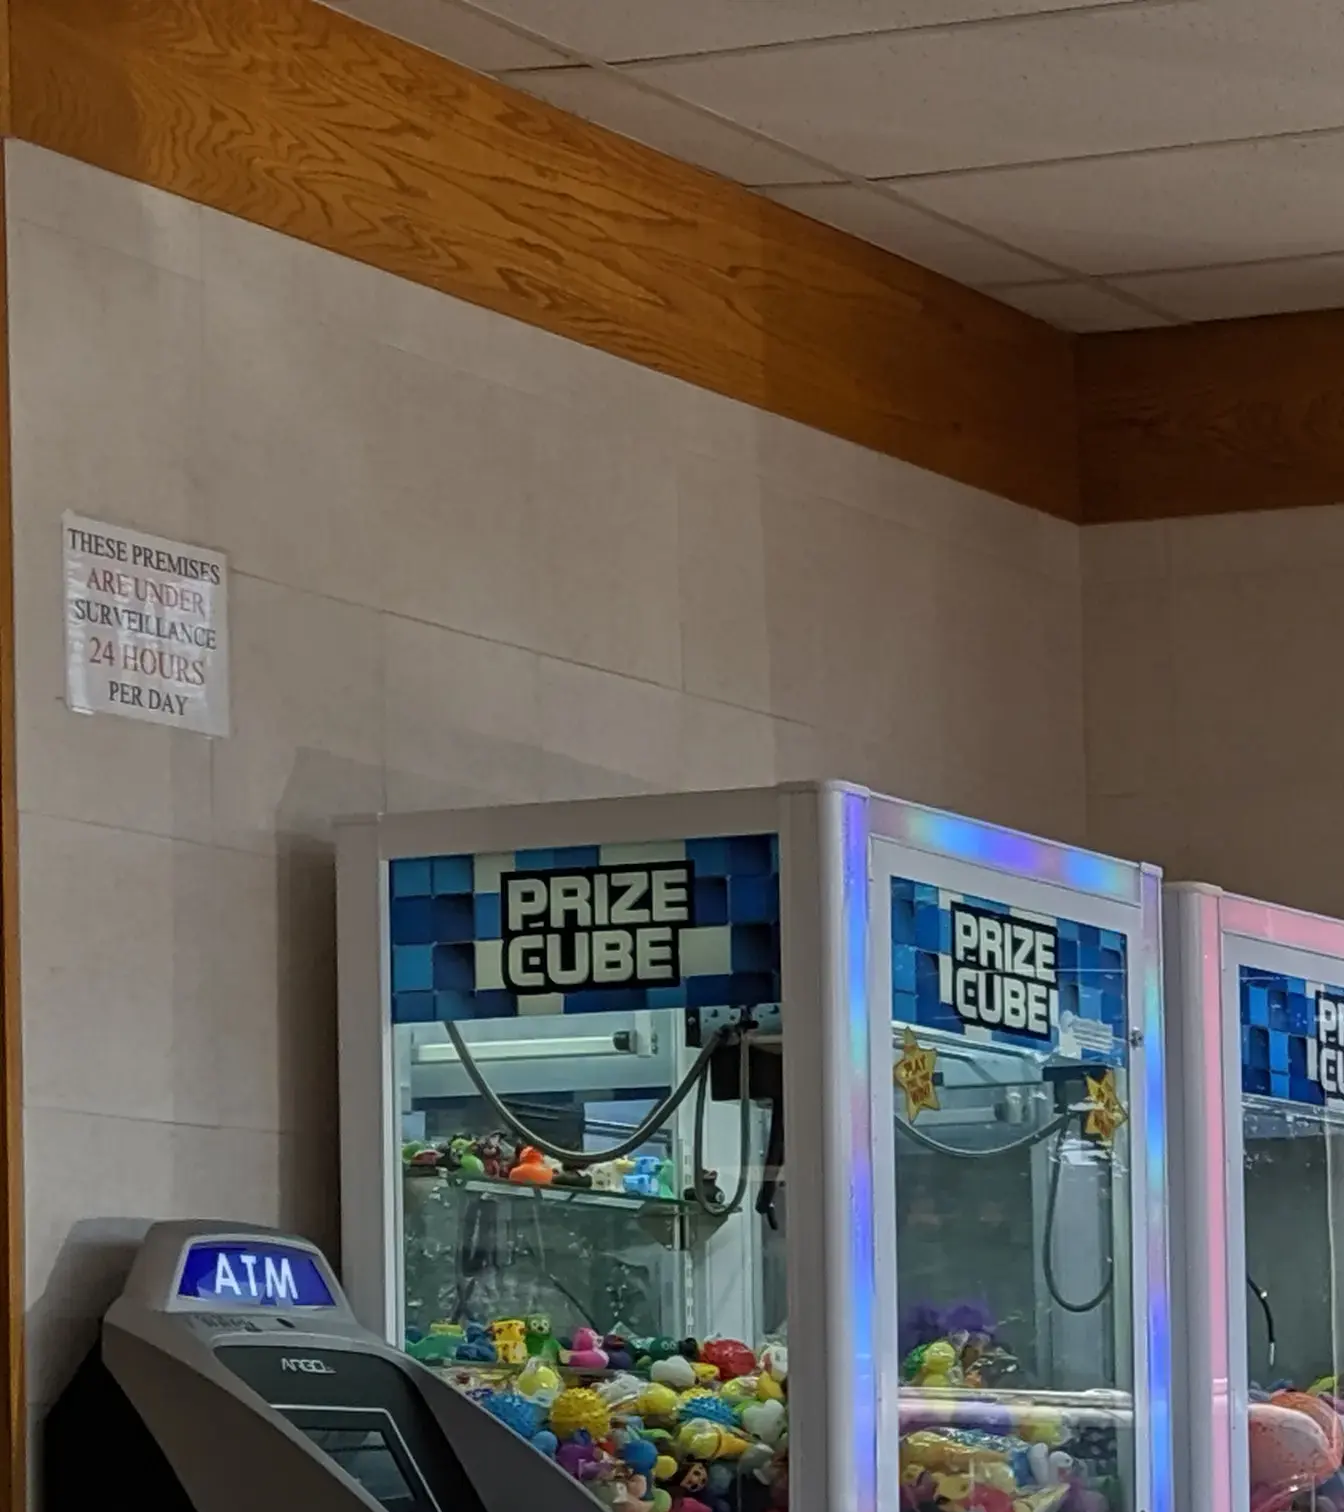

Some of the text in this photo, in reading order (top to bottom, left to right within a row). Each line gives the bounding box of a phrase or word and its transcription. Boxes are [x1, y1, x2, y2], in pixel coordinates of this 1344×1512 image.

[67, 528, 221, 585] THESE PREMISES
[86, 567, 206, 616] ARE UNDER
[75, 598, 217, 650] SURVEILLANCE
[89, 636, 206, 686] 24 HOURS
[108, 680, 189, 716] PER DAY
[508, 868, 689, 931] PRIZE
[508, 926, 674, 987] CUBE
[954, 910, 1057, 983] PRIZE
[955, 966, 1049, 1035] CUBE
[215, 1252, 299, 1300] ATM
